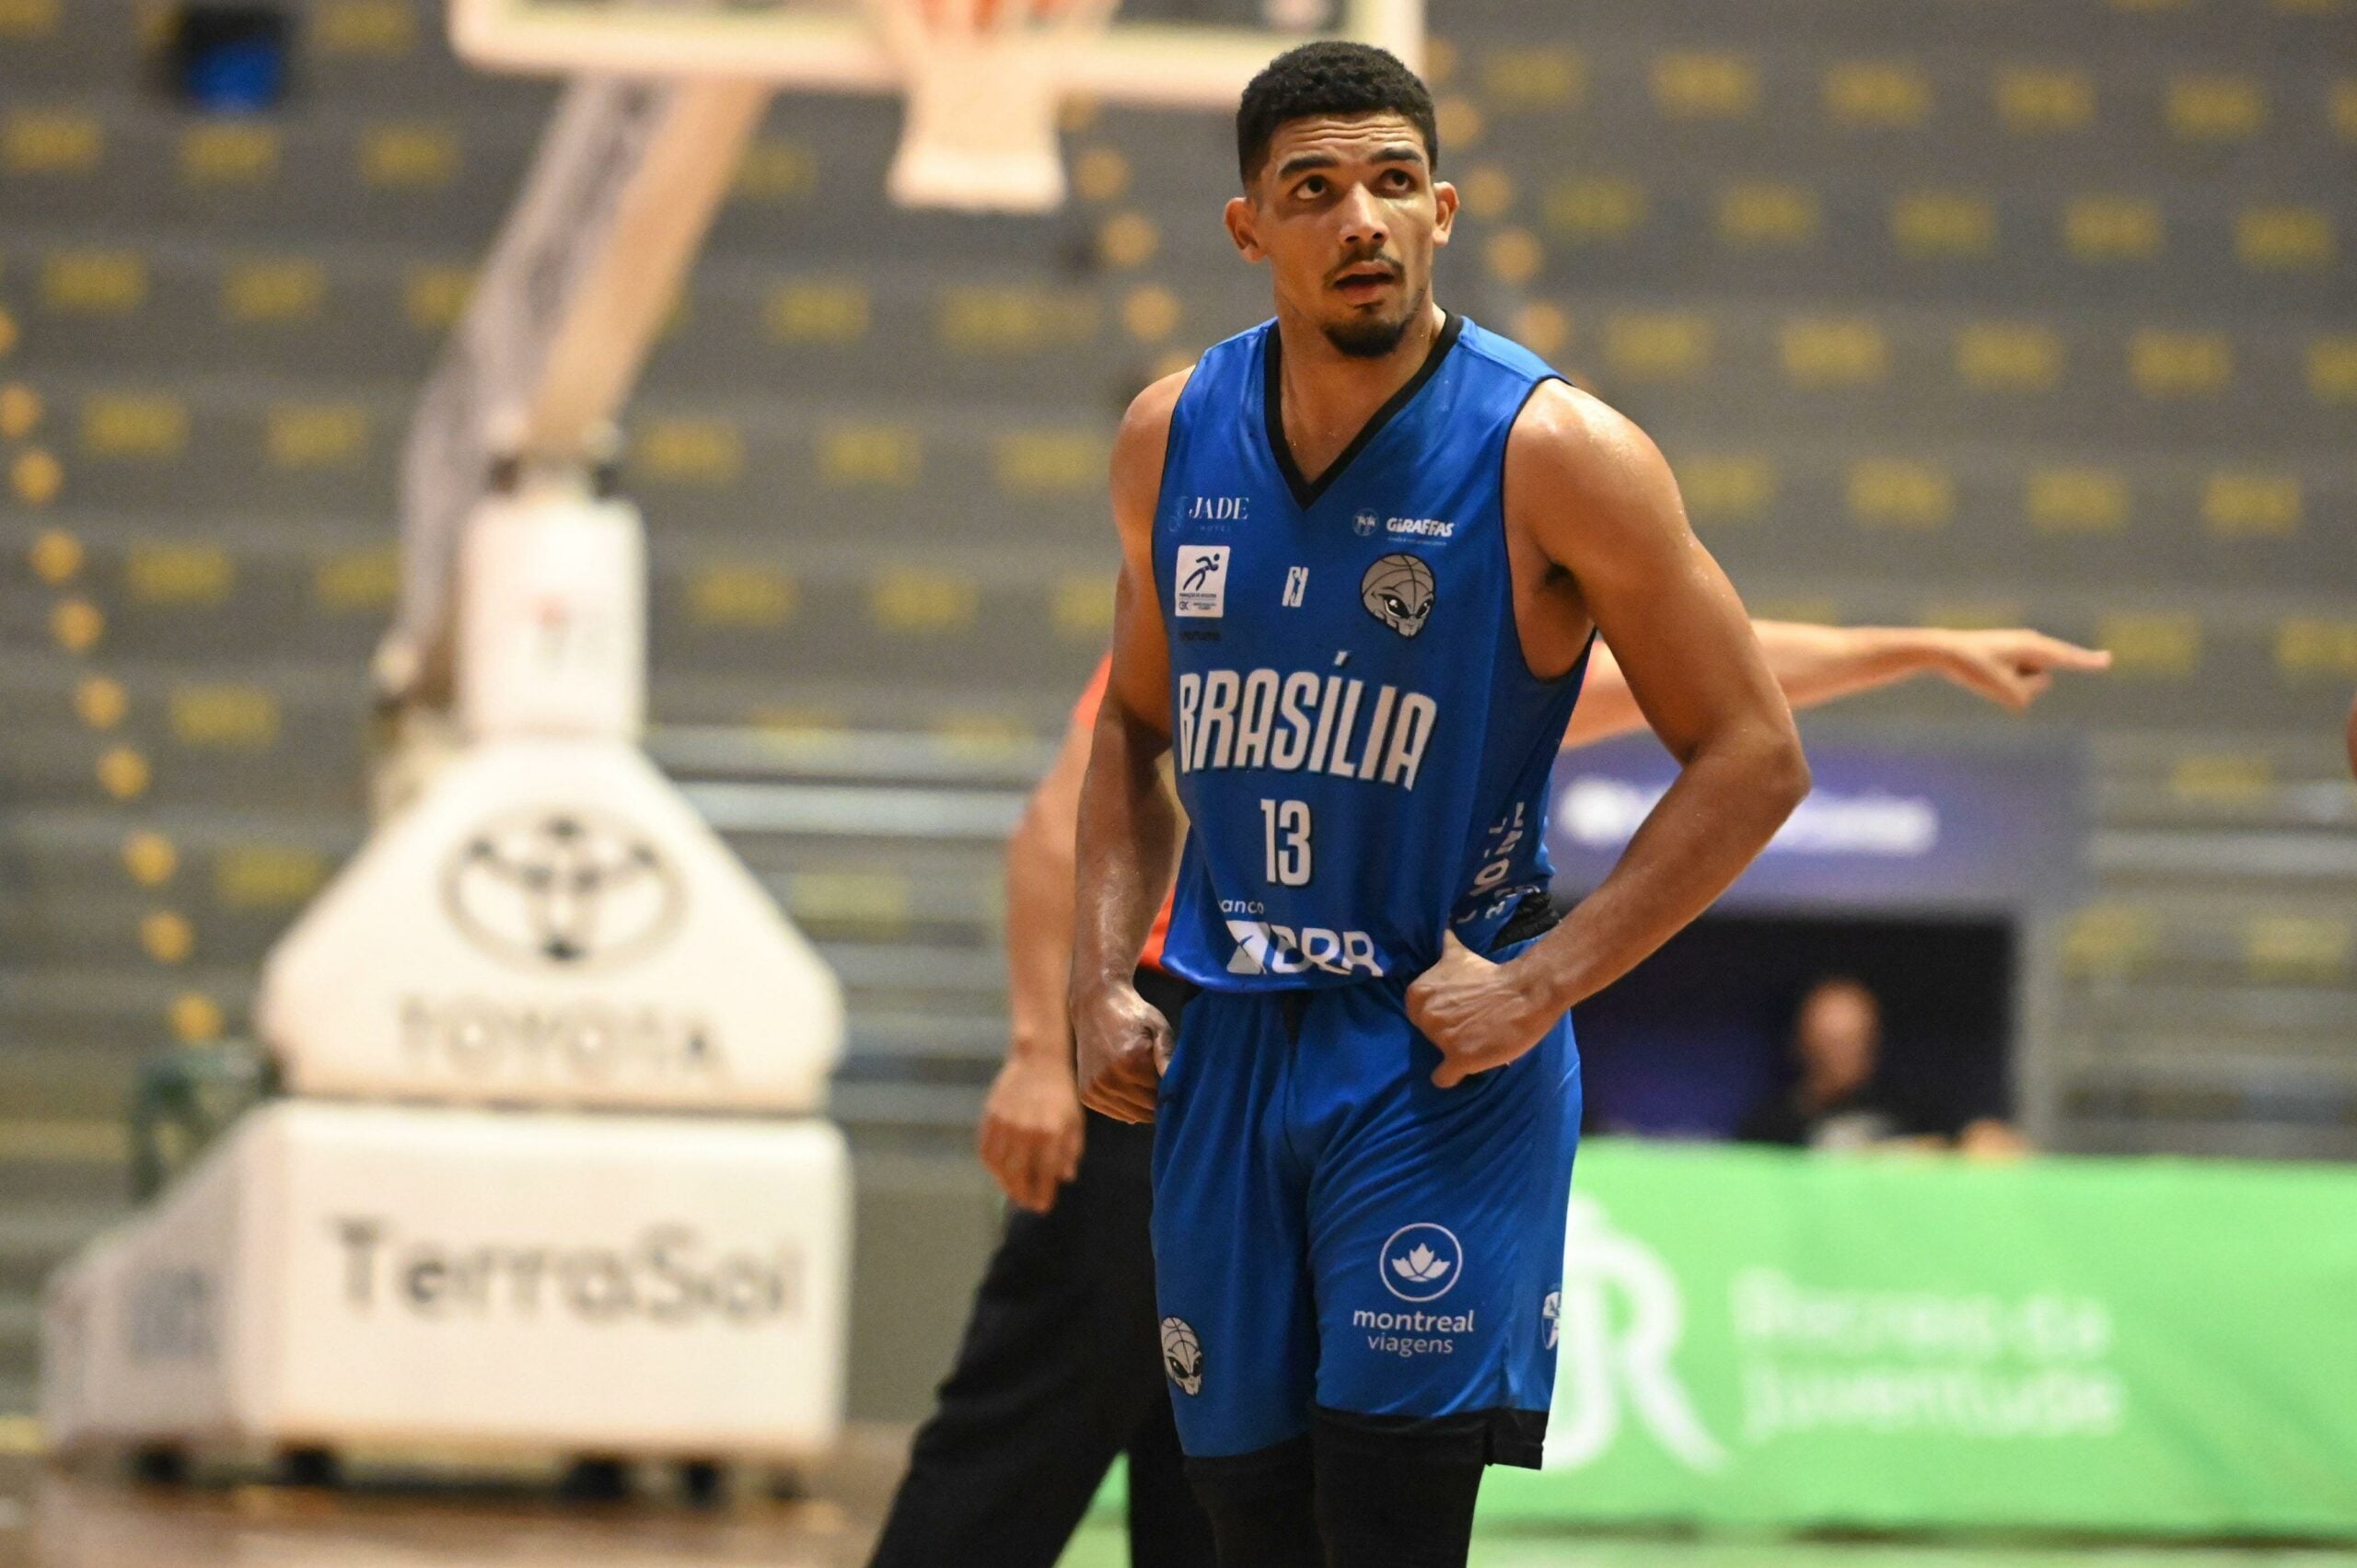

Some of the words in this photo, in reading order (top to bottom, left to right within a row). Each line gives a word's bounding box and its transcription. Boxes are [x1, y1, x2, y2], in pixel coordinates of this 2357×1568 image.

[1189, 496, 1249, 520] JADE
[1179, 650, 1438, 792] BRASÍLIA
[1260, 798, 1312, 887] 13
[1219, 899, 1264, 915] anco
[396, 994, 727, 1075] TOYOTA
[333, 1218, 805, 1324] TerraSol
[1353, 1309, 1475, 1333] montreal
[1367, 1333, 1454, 1357] viagens
